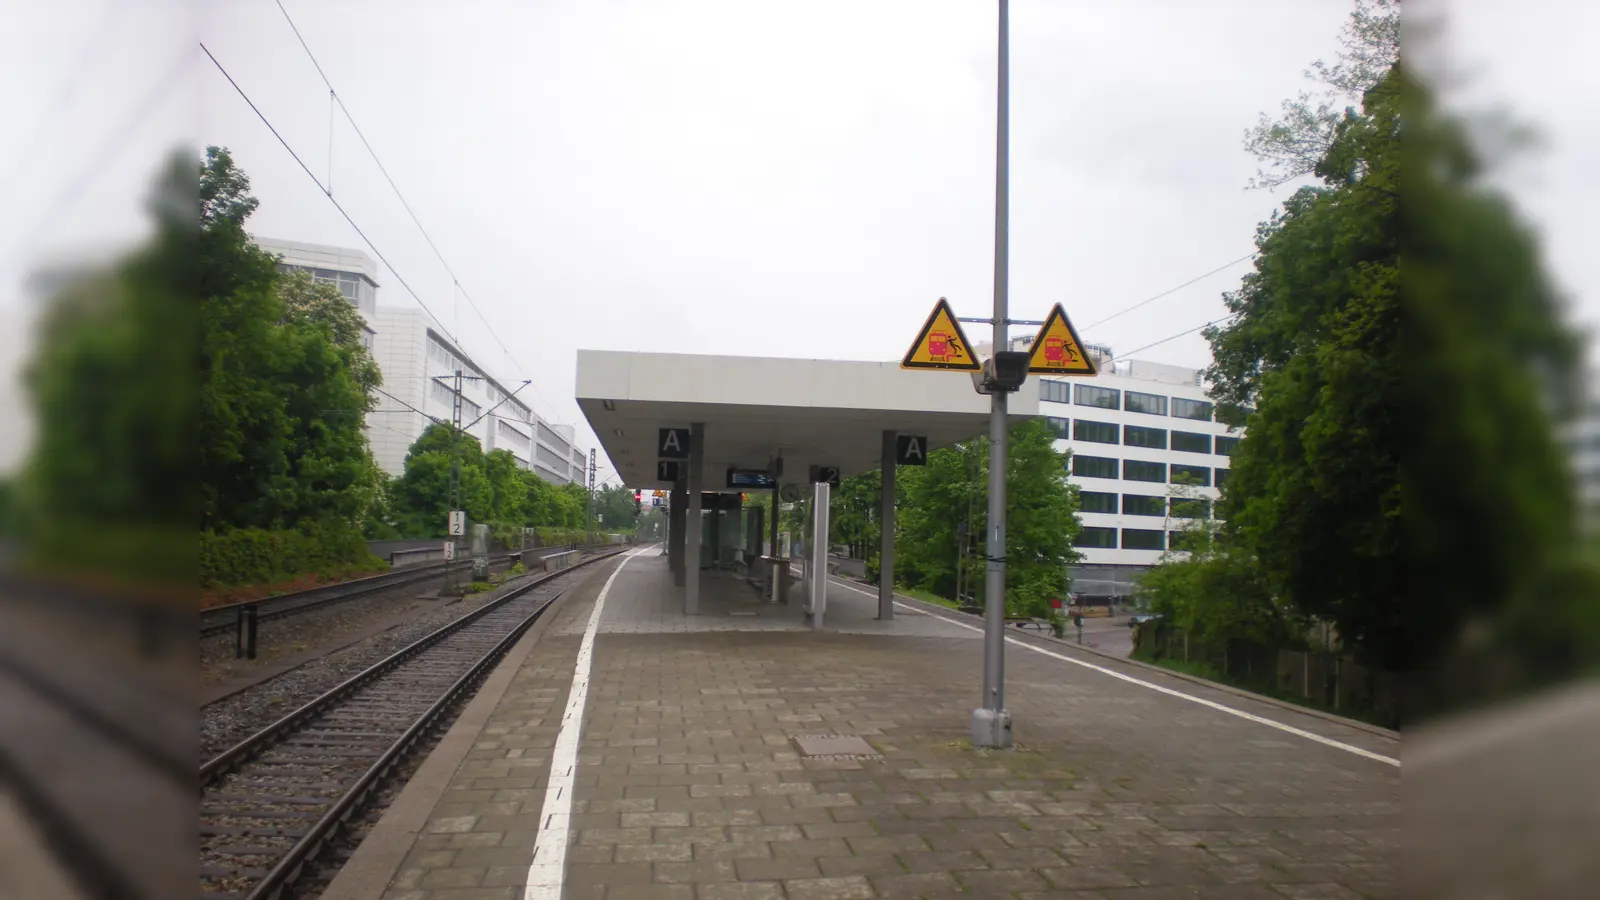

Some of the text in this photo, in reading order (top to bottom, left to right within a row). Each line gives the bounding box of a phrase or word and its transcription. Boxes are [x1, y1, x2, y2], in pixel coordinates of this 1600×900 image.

[663, 430, 681, 452] A
[905, 438, 922, 459] A
[661, 462, 667, 477] 1
[827, 468, 837, 482] 2
[453, 524, 460, 533] 2
